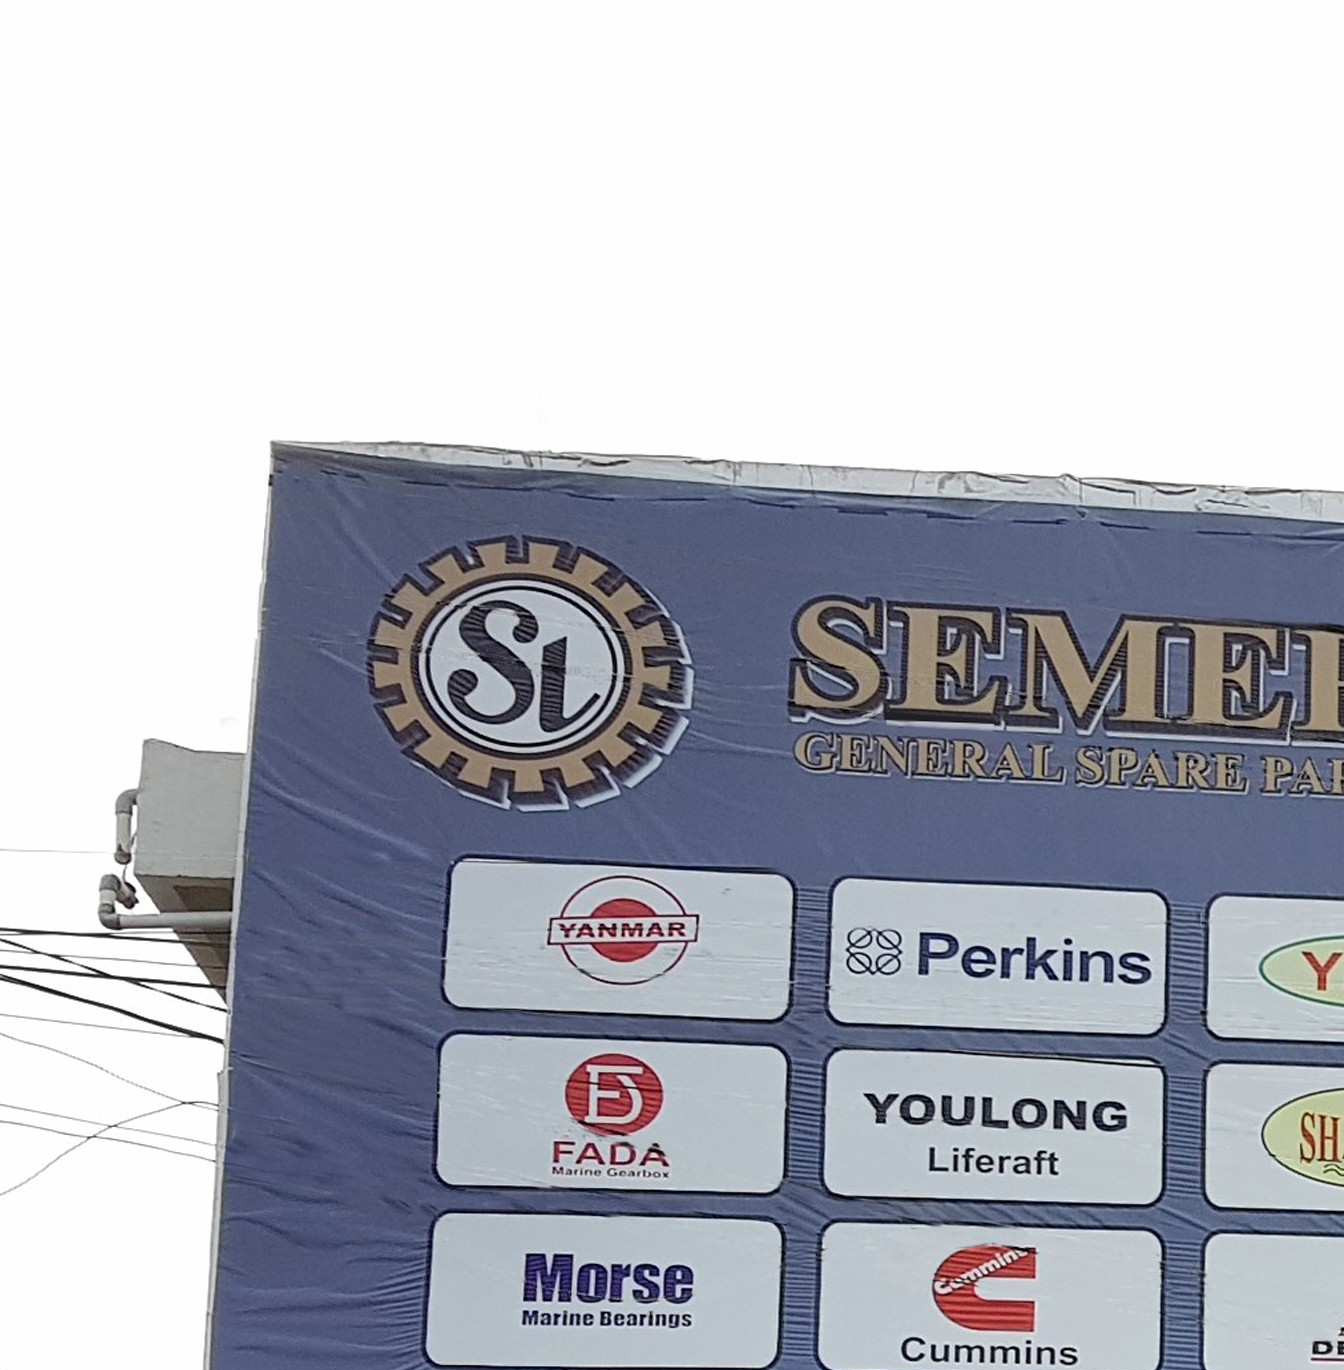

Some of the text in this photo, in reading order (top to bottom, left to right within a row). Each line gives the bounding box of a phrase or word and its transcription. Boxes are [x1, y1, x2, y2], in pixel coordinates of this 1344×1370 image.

[794, 732, 1066, 786] GENERAL
[1074, 746, 1248, 795] SPARE
[558, 920, 688, 941] YANMAR
[917, 930, 1153, 986] Perkins
[863, 1093, 1128, 1132] YOULONG
[552, 1140, 671, 1168] FADA
[928, 1148, 1060, 1176] Liferaft
[552, 1165, 670, 1180] Marine Gearbox
[521, 1252, 694, 1305] Morse
[521, 1309, 693, 1330] Marine Bearings
[900, 1336, 1080, 1367] Cummins
